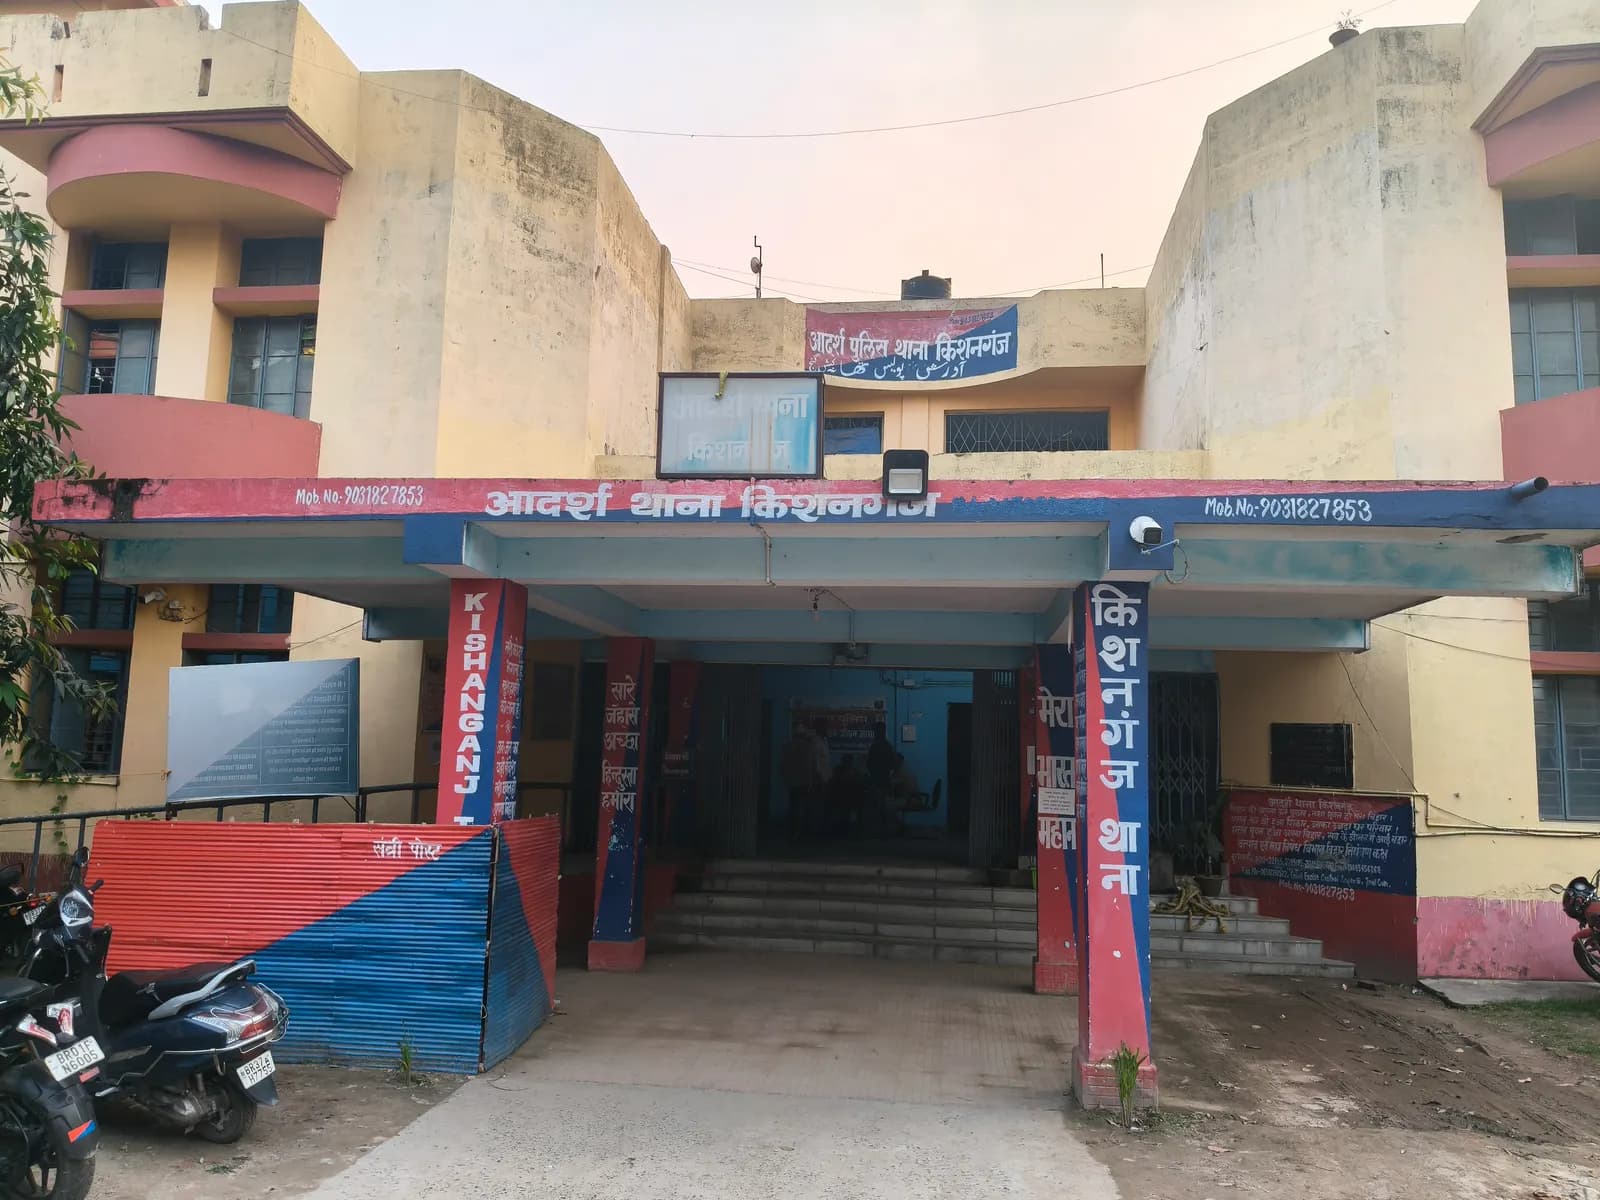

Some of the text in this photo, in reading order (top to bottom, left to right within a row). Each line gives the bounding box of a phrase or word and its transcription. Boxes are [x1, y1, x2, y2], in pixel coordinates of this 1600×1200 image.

[808, 328, 1012, 362] आदर्श पुलिस थाना किशनगंज
[484, 484, 613, 521] आदर्श
[630, 492, 728, 519] थाना
[453, 592, 488, 795] KISHANGANJ
[1036, 686, 1075, 729] मेरा
[1036, 754, 1076, 788] भारत
[408, 835, 442, 861] पोस्ट
[1038, 816, 1077, 850] महान
